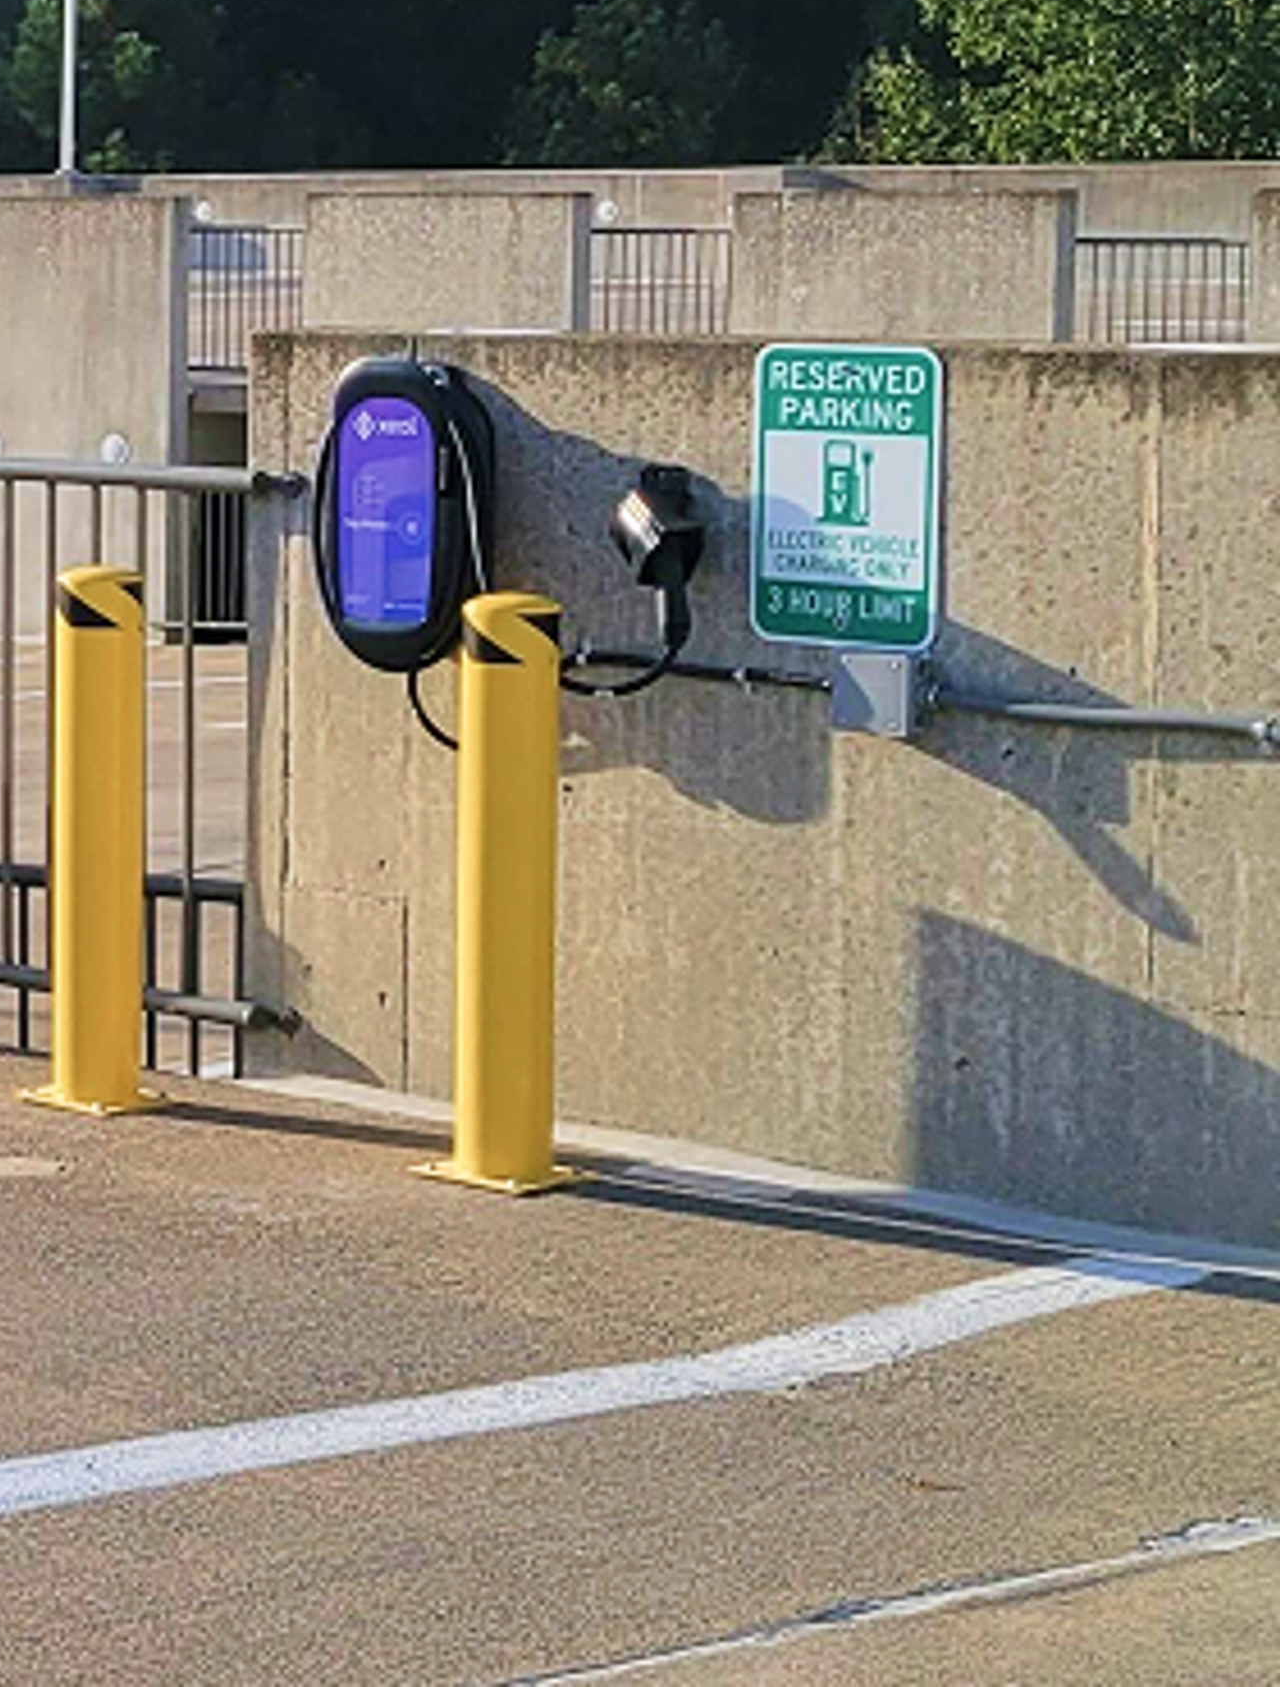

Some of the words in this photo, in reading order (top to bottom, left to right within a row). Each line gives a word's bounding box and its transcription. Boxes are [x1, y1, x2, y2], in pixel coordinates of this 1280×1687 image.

[768, 361, 926, 395] RESERVED
[778, 396, 913, 431] PARKING
[769, 530, 844, 553] ELECTRIC
[849, 535, 919, 559] VEHICLE
[776, 553, 860, 577] CHARGING
[864, 558, 910, 581] ONLY
[767, 585, 783, 614] 3
[788, 588, 851, 618] HOUR
[859, 593, 916, 623] LIMIT
